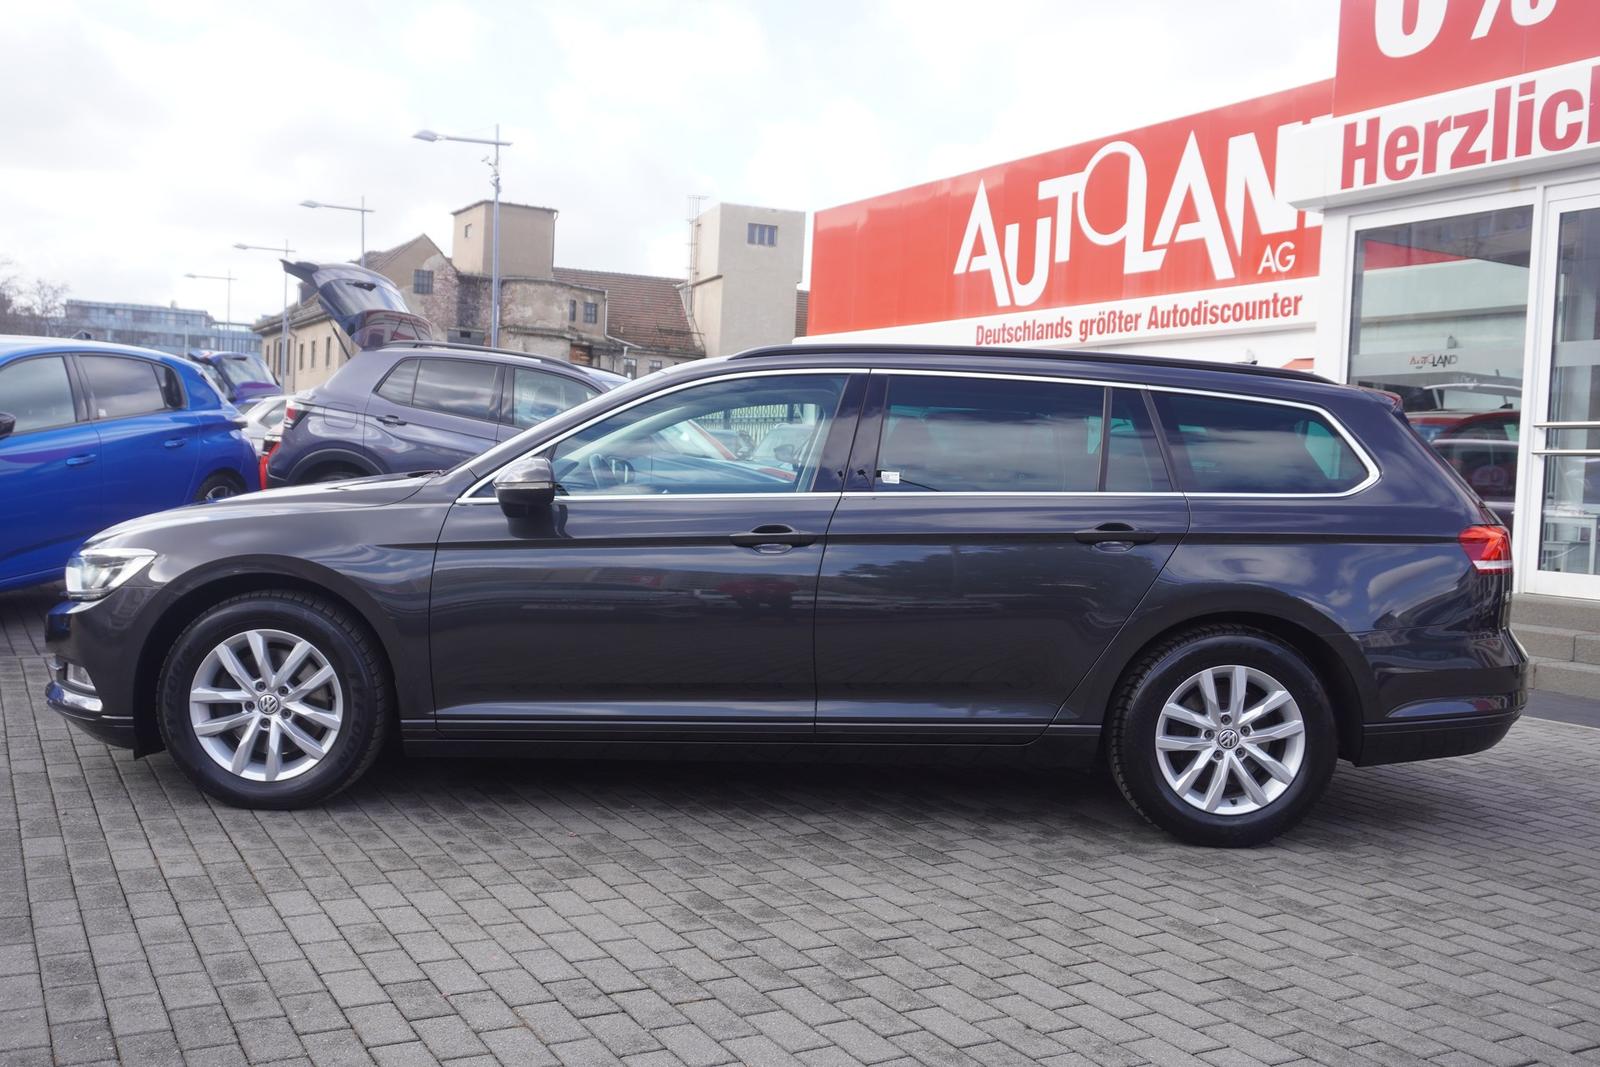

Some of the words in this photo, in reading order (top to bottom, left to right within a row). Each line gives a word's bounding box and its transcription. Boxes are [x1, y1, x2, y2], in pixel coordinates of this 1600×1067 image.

[1257, 240, 1296, 275] AG
[975, 315, 1073, 346] Deutschlands
[1078, 308, 1142, 342] größter
[1147, 291, 1303, 330] Autodiscounter
